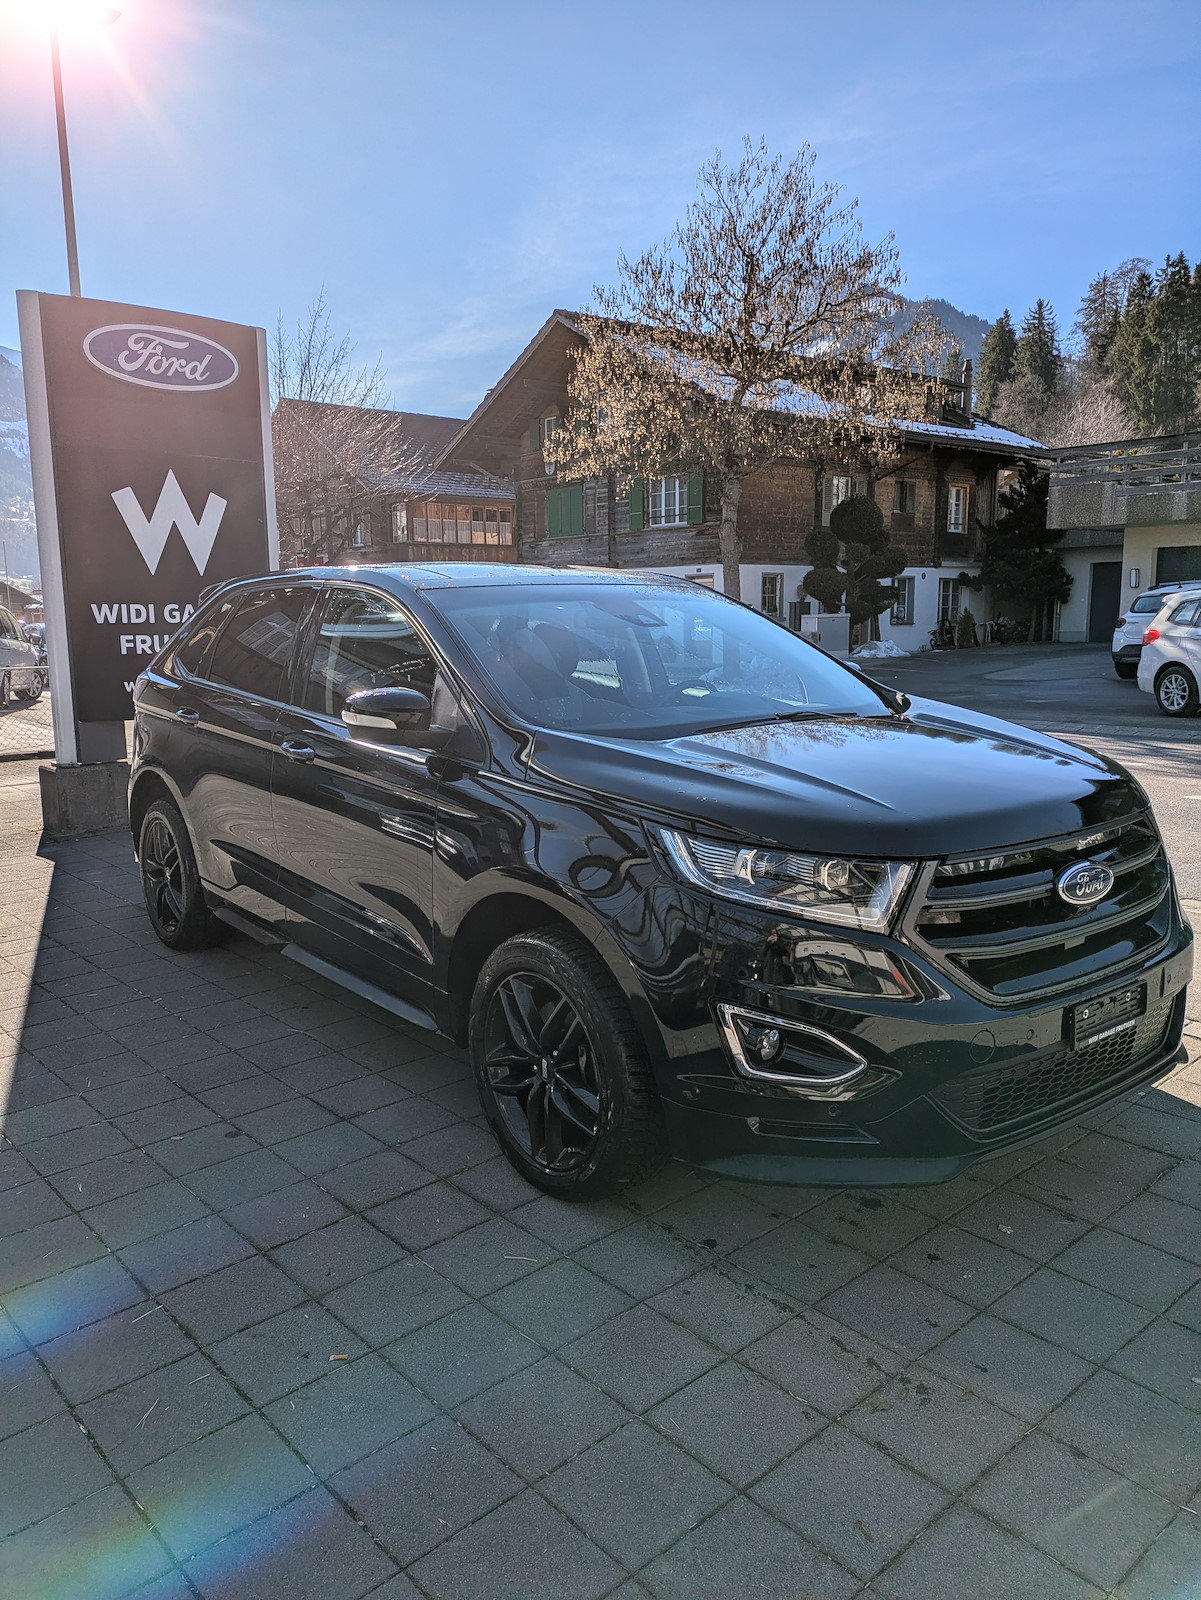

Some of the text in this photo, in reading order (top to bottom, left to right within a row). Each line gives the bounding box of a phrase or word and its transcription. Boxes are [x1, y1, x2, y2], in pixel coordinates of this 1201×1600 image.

[118, 332, 213, 381] Ford
[111, 468, 228, 577] W
[90, 603, 195, 624] WIDI GA
[120, 634, 171, 655] FRU
[1075, 868, 1105, 896] Ford
